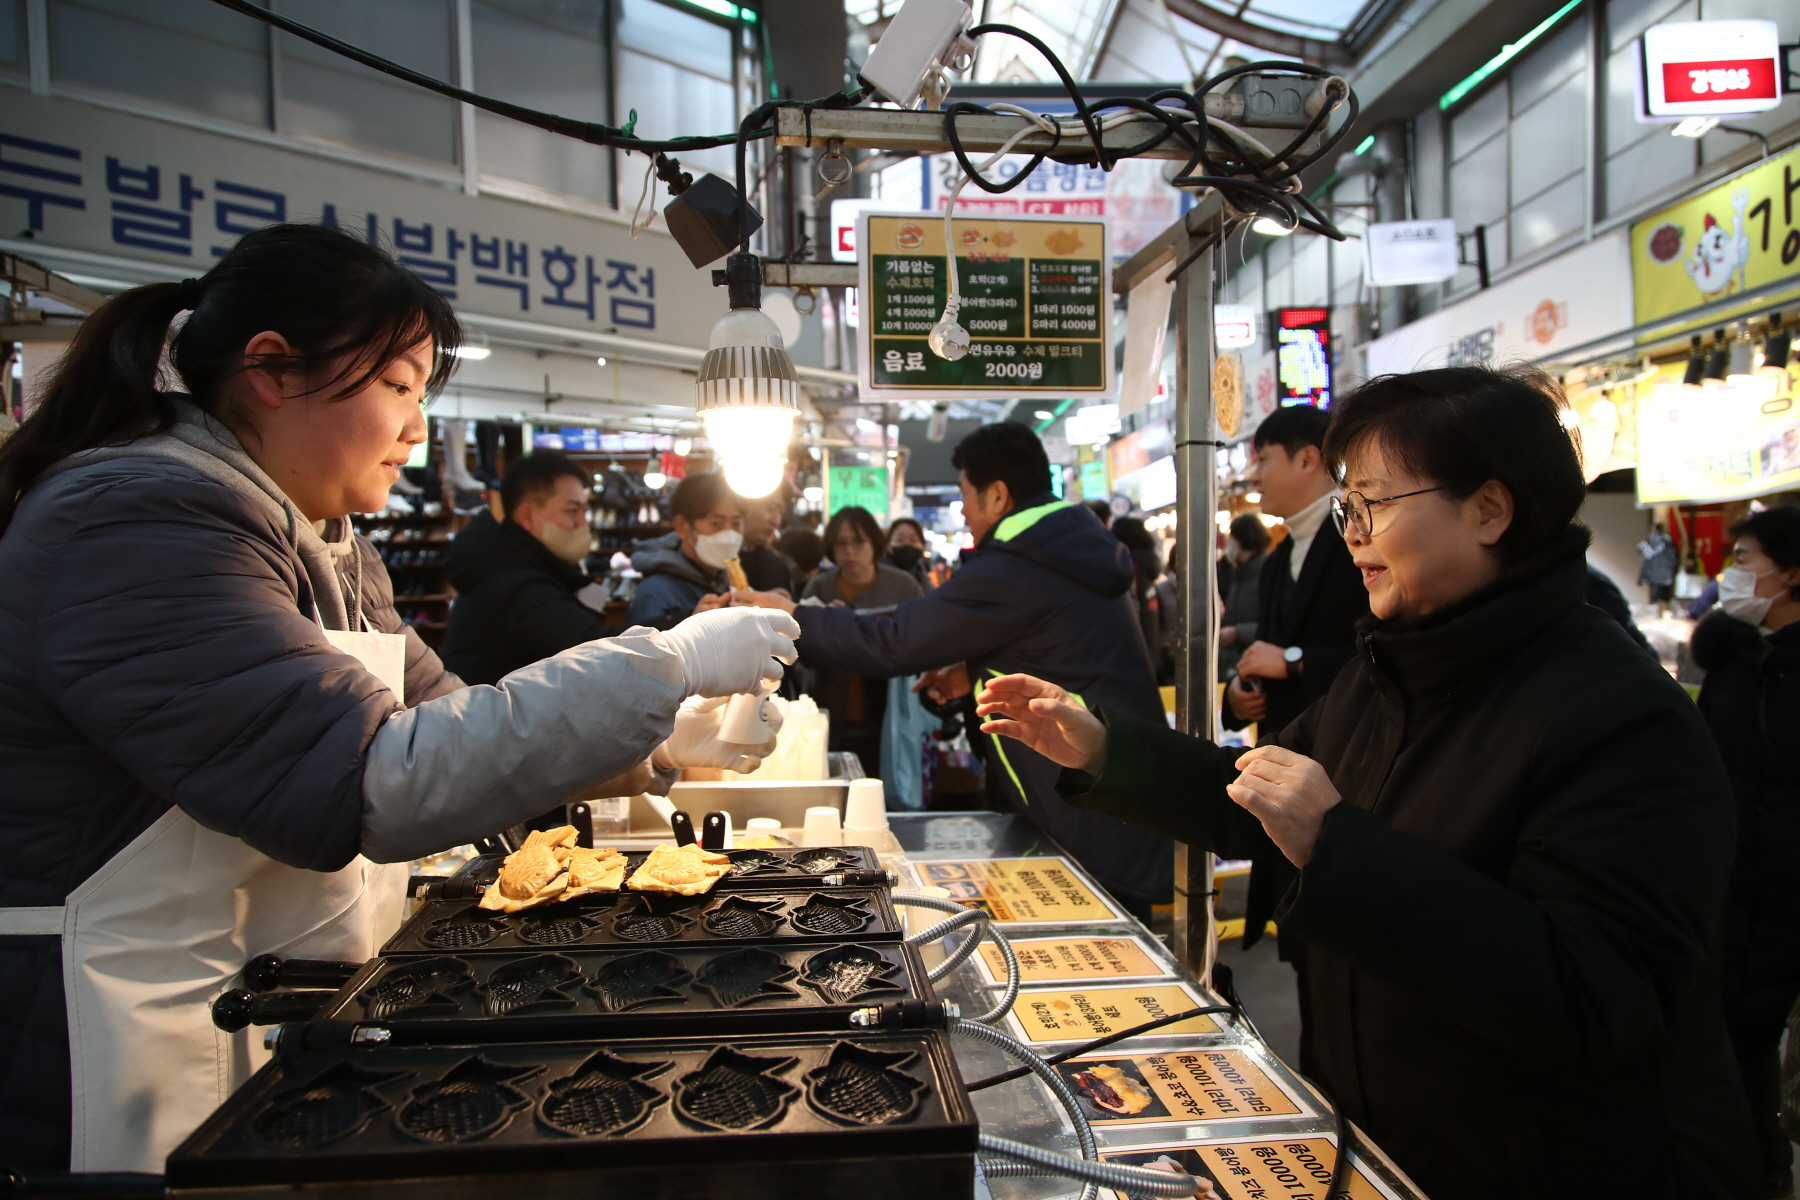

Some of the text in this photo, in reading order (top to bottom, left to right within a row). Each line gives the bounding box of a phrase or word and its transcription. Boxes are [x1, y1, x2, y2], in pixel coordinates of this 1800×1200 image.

[886, 260, 935, 274] 기름없는
[1070, 265, 1092, 274] 붕어빵
[886, 276, 934, 289] 수제호떡
[969, 274, 1008, 284] 호떡(2개)
[1077, 275, 1099, 284] 붕어빵
[1070, 285, 1092, 295] 붕어빵
[887, 294, 935, 304] 1개 1500원
[961, 297, 1017, 308] 붕어빵(3마리)
[886, 307, 936, 318] 4개 5000원
[1034, 304, 1095, 315] 1마리 1000원
[882, 321, 901, 330] 10개
[970, 319, 1008, 330] 5000원
[1033, 319, 1096, 331] 5마리 4000원
[1023, 345, 1046, 356] 수제
[1049, 345, 1083, 357] 밀크티
[883, 350, 926, 372] 음료
[985, 362, 1043, 378] 2000원
[1016, 950, 1038, 971] 기름없는
[1032, 949, 1058, 970] 수제호떡
[1074, 944, 1105, 971] 4개 5000원
[1067, 962, 1084, 972] 1개
[1031, 1002, 1061, 1030] 호떡(2개)
[1070, 994, 1111, 1034] 붕어빵(3마리)
[1101, 1005, 1121, 1019] 세트
[1135, 996, 1170, 1022] 000원
[1146, 1056, 1206, 1117] 슈&초코 붕어빵
[1175, 1055, 1240, 1114] 1마리 1000원
[1204, 1053, 1272, 1113] 5마리 4000원
[1213, 1147, 1251, 1176] 붕어빵
[1250, 1146, 1306, 1190] 1000원
